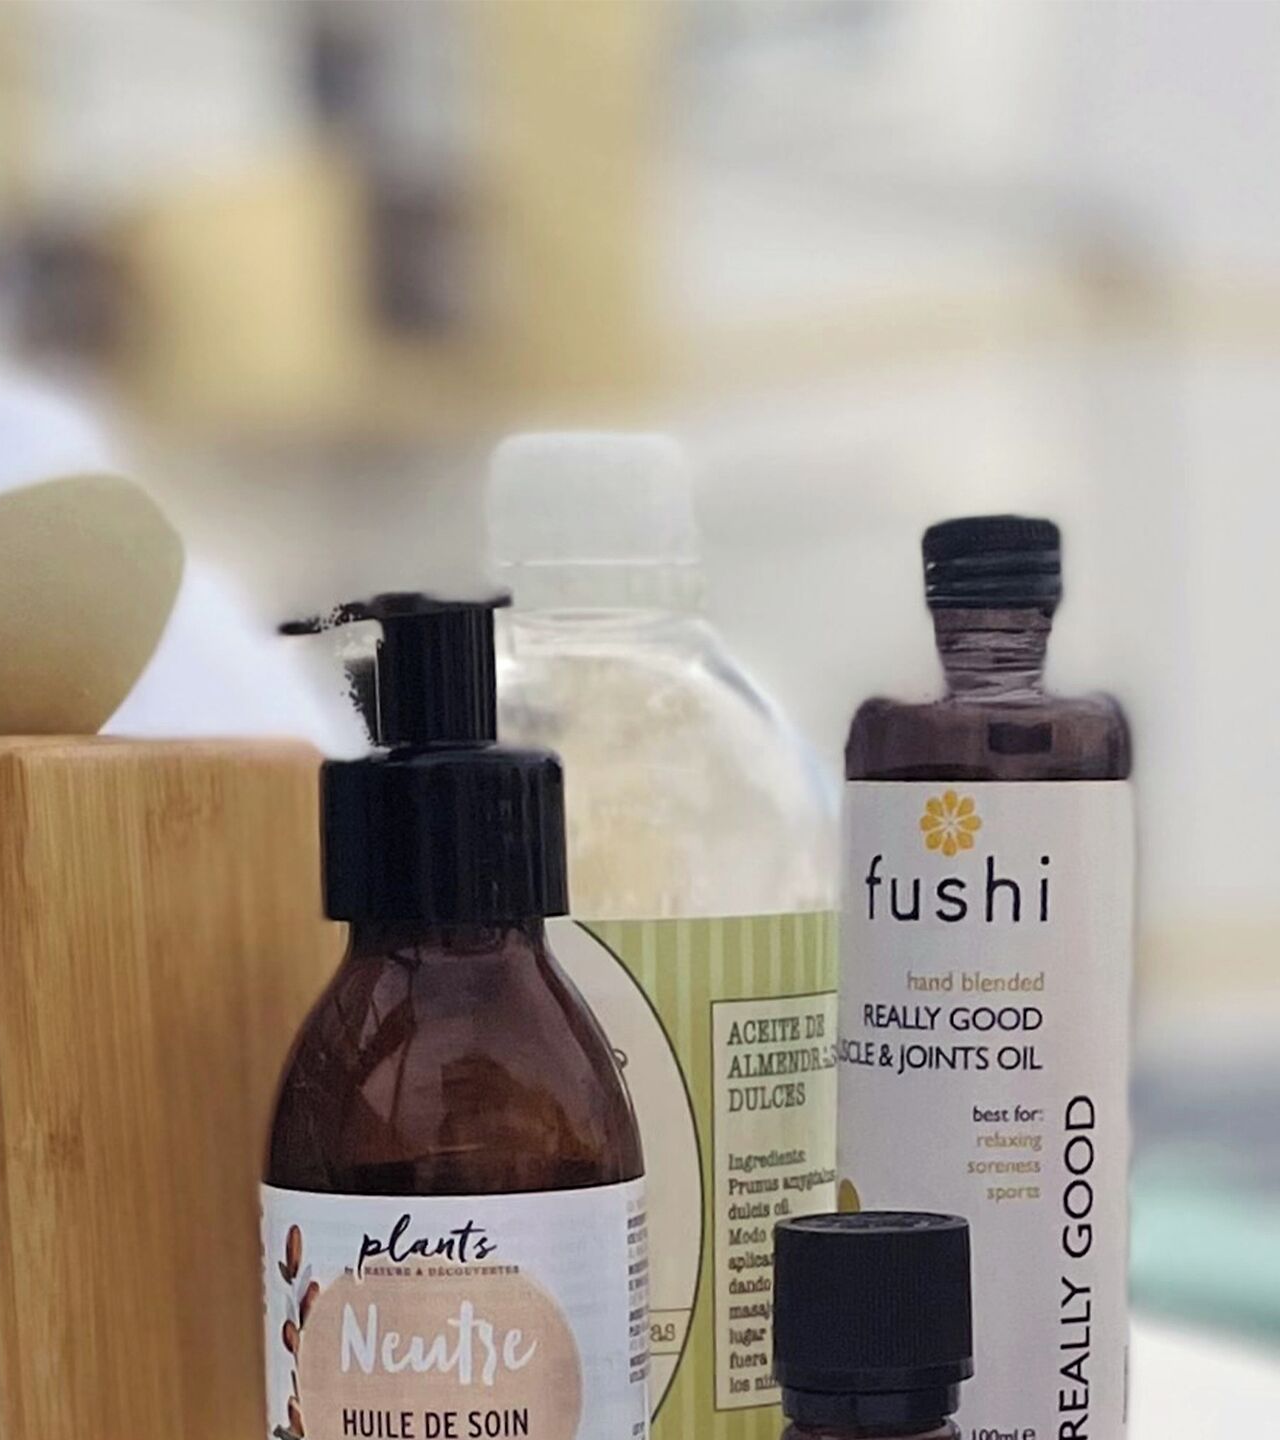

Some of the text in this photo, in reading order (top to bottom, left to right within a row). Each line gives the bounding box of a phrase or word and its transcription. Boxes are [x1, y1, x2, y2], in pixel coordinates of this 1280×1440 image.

[865, 853, 1051, 923] fushi
[906, 970, 1046, 993] hand blended
[862, 1003, 1044, 1033] REALLY GOOD
[726, 1013, 825, 1046] ACEITE DE
[878, 1043, 894, 1068] &
[897, 1043, 989, 1077] JOINTS
[996, 1045, 1043, 1071] OIL
[728, 1081, 807, 1113] DULCES
[972, 1104, 1045, 1123] best for:
[975, 1131, 1043, 1152] relaxing
[966, 1158, 1042, 1175] soreness
[1061, 1094, 1097, 1259] GOOD
[728, 1177, 780, 1196] Prunus
[986, 1183, 1042, 1201] sports
[728, 1200, 771, 1220] dulcis
[357, 1213, 498, 1279] plants
[728, 1226, 767, 1246] Modo
[728, 1276, 771, 1295] dando
[339, 1300, 537, 1386] Neutre
[729, 1327, 767, 1347] lugar
[729, 1350, 768, 1370] fuera
[342, 1407, 530, 1440] HUILE DE SOIN
